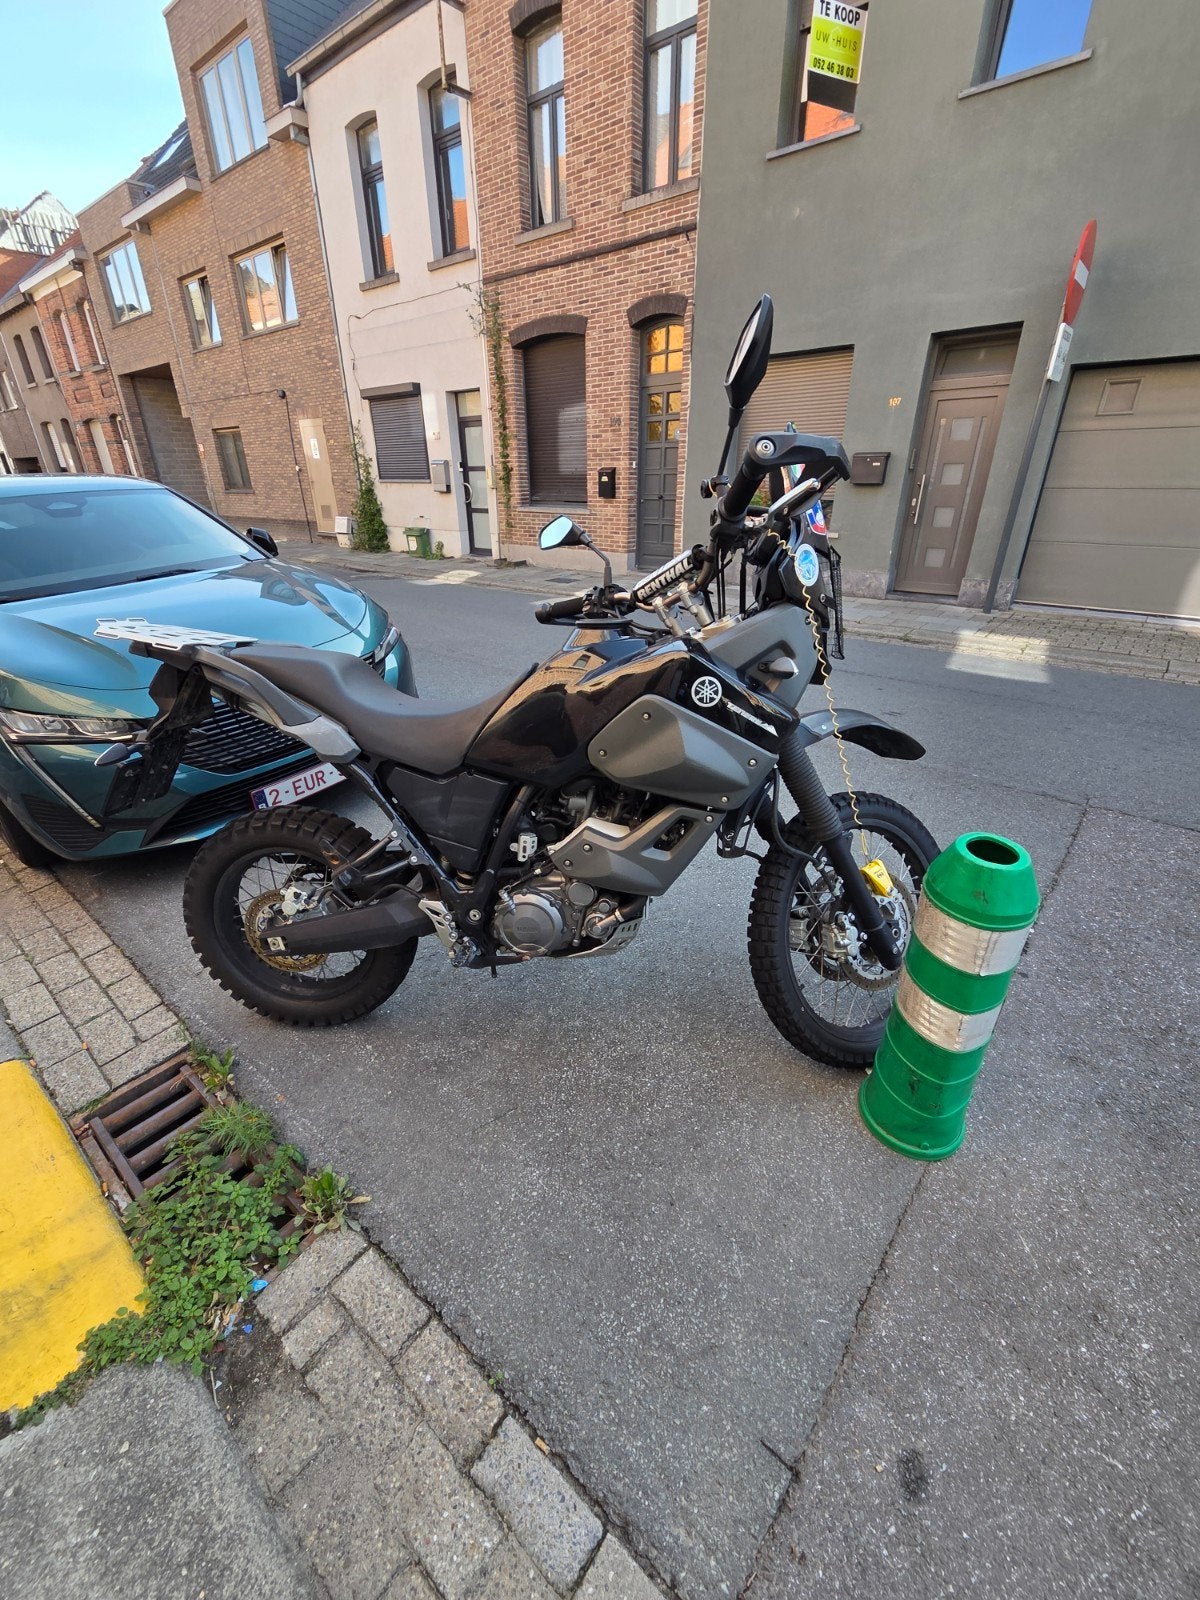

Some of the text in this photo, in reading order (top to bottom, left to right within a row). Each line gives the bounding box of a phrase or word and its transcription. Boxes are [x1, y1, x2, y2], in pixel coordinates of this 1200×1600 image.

[820, 0, 861, 26] TE KOOP
[813, 57, 855, 78] 052 46 38 03
[636, 557, 694, 601] RENTHAL
